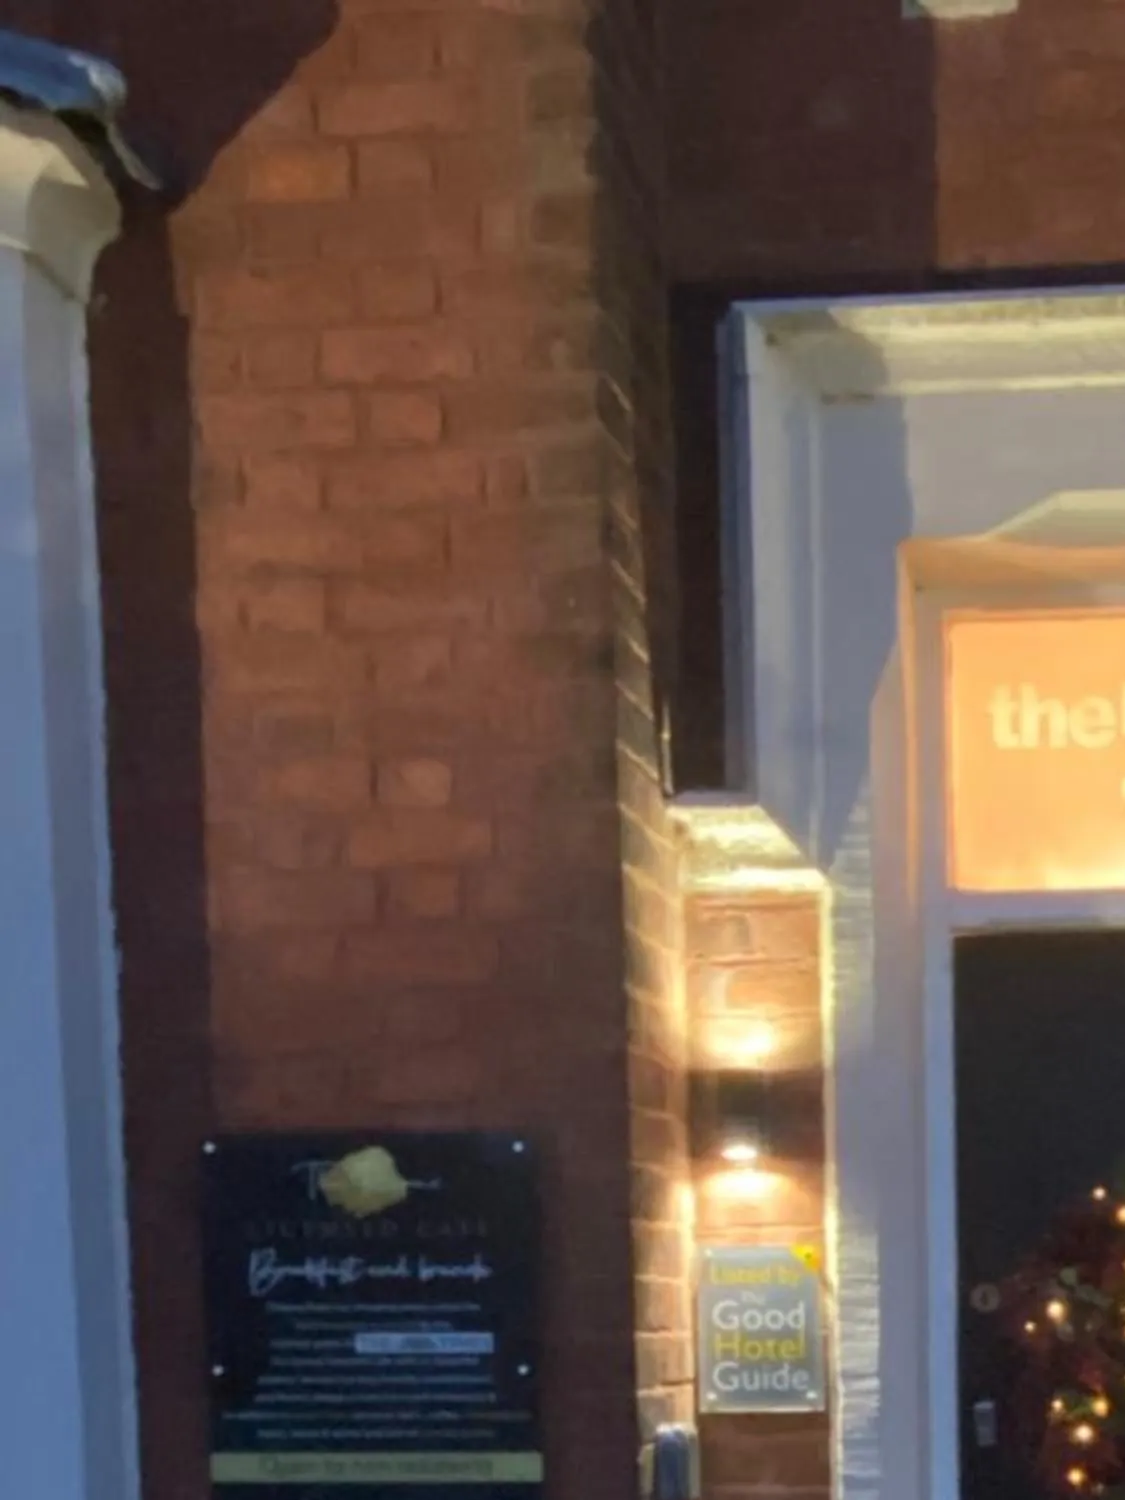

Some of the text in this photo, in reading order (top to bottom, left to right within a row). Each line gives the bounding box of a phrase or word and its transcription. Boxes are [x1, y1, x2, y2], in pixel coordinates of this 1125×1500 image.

[711, 1299, 806, 1331] Good
[714, 1331, 805, 1361] Hotel
[712, 1360, 811, 1392] Guide
